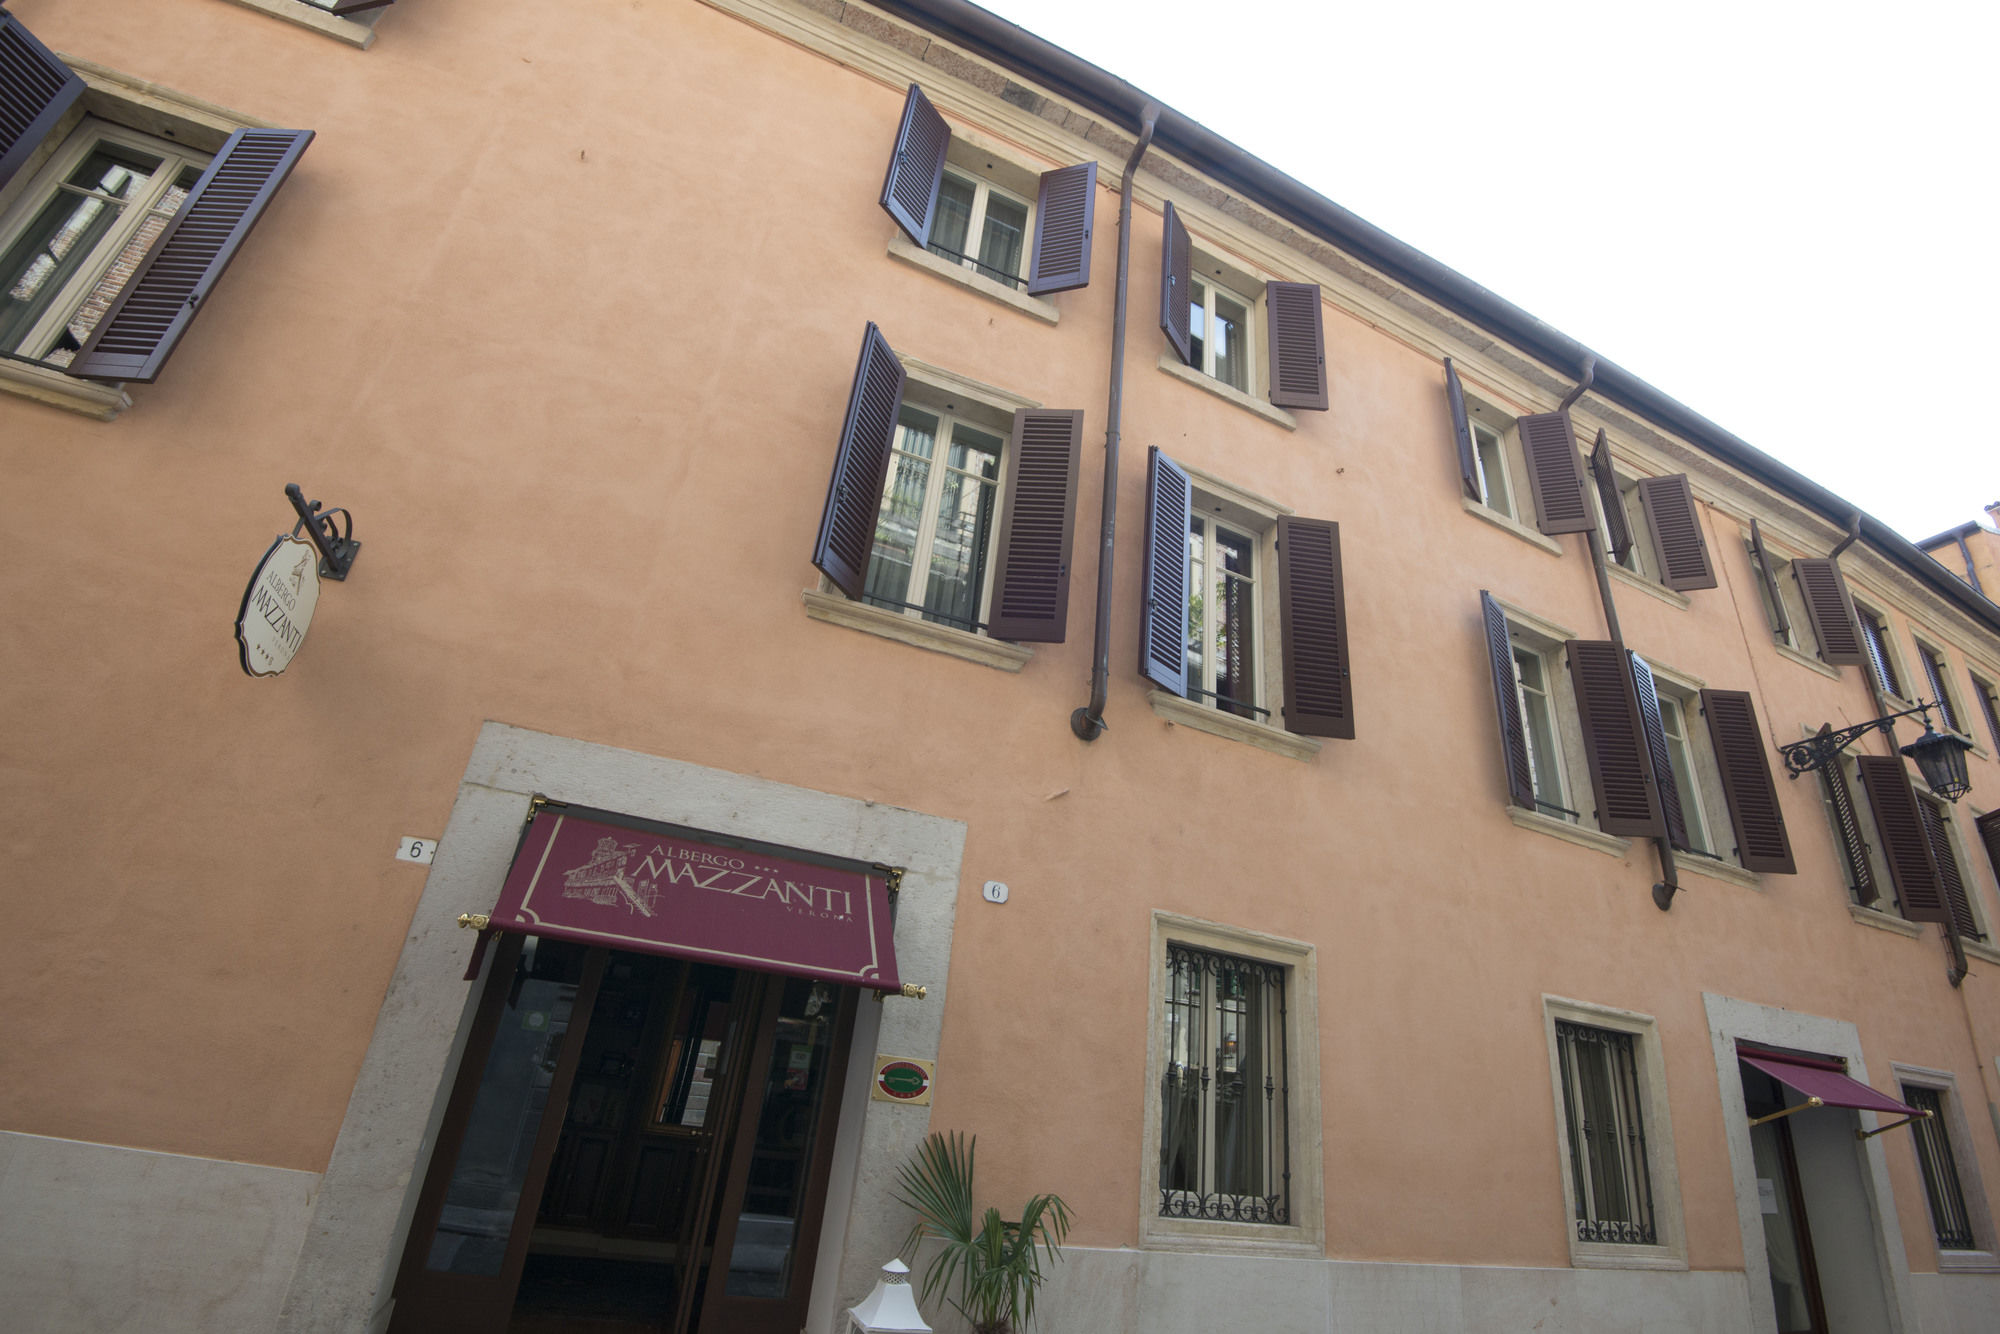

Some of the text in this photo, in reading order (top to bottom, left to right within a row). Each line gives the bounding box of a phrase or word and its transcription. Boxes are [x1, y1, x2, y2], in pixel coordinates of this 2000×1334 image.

[267, 572, 296, 611] ALBERGO
[252, 585, 302, 653] MAZZANTI
[410, 841, 423, 858] 6
[651, 844, 745, 870] ALBERGO
[632, 855, 852, 914] MAZZANTI
[992, 884, 1000, 899] 6
[786, 906, 854, 923] VERONA
